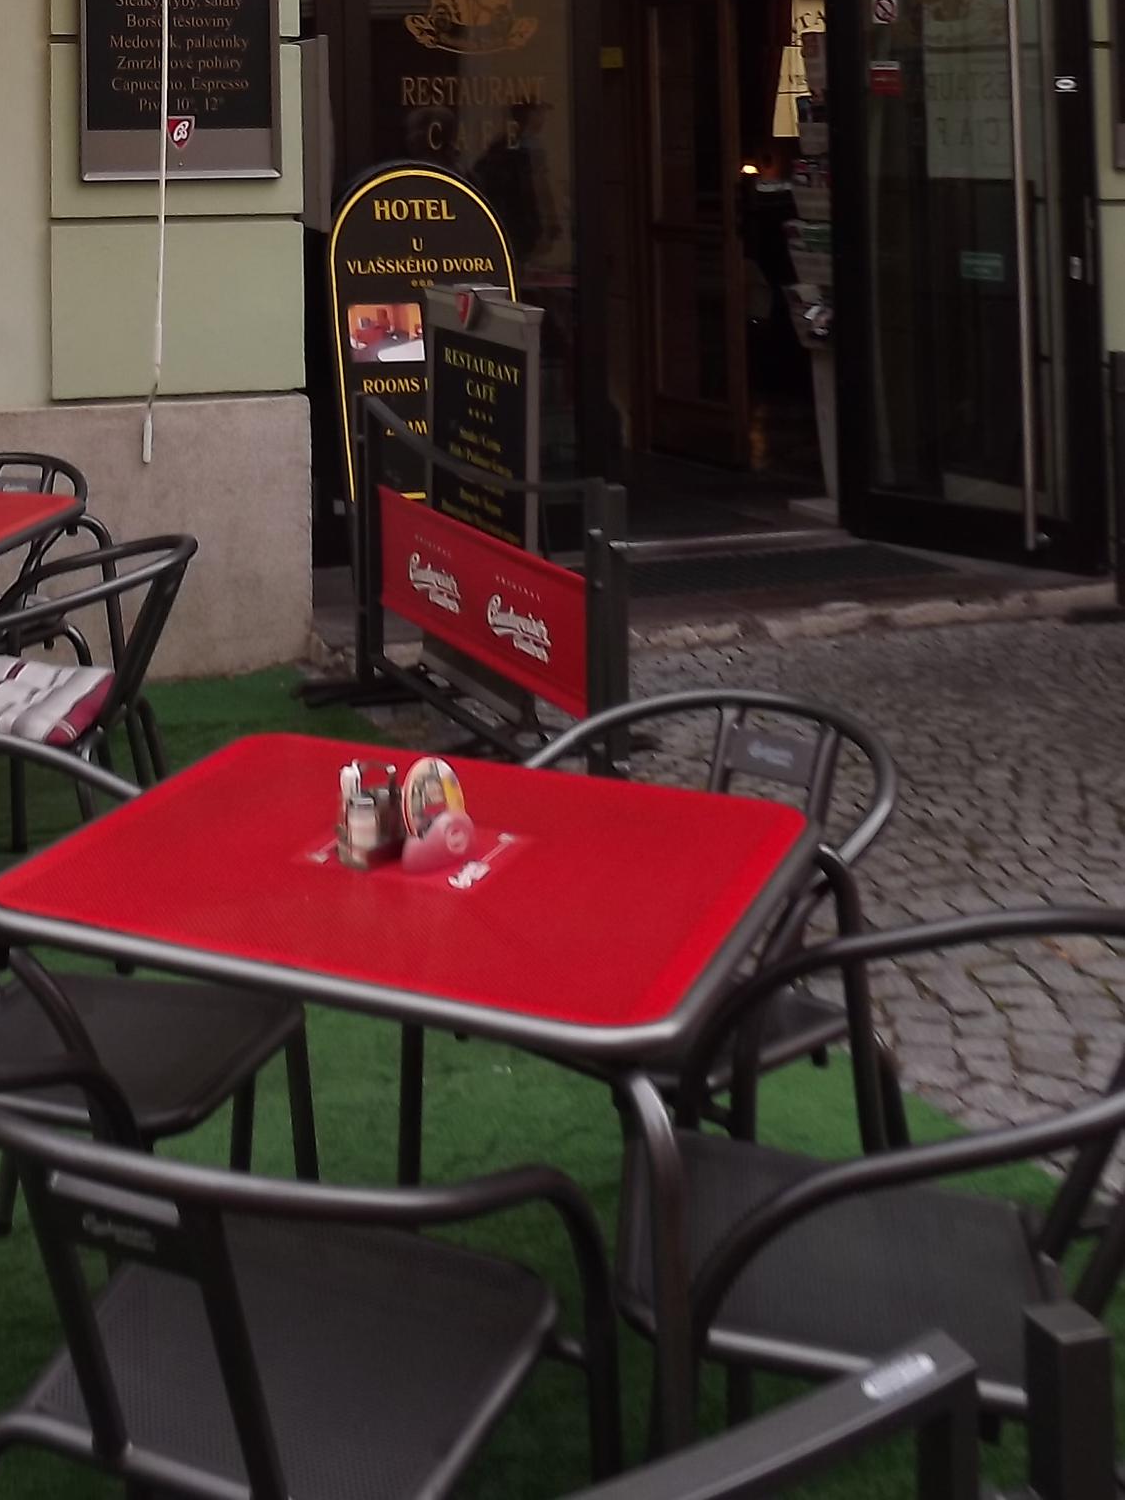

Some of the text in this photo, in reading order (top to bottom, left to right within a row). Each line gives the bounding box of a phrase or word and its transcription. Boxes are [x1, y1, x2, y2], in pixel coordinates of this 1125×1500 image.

[126, 12, 164, 28] Borš
[109, 34, 182, 50] Medovk,
[117, 55, 193, 71] Zmrzliové
[111, 77, 250, 93] Capuccno, Espresso
[402, 75, 544, 107] RESTAURANT
[139, 98, 164, 112] Piv
[374, 199, 457, 221] HOTEL
[411, 237, 424, 252] U
[347, 255, 495, 275] VLAŠSKÉHO DVORA
[443, 346, 521, 387] RESTAURANT
[362, 377, 420, 394] ROOMS
